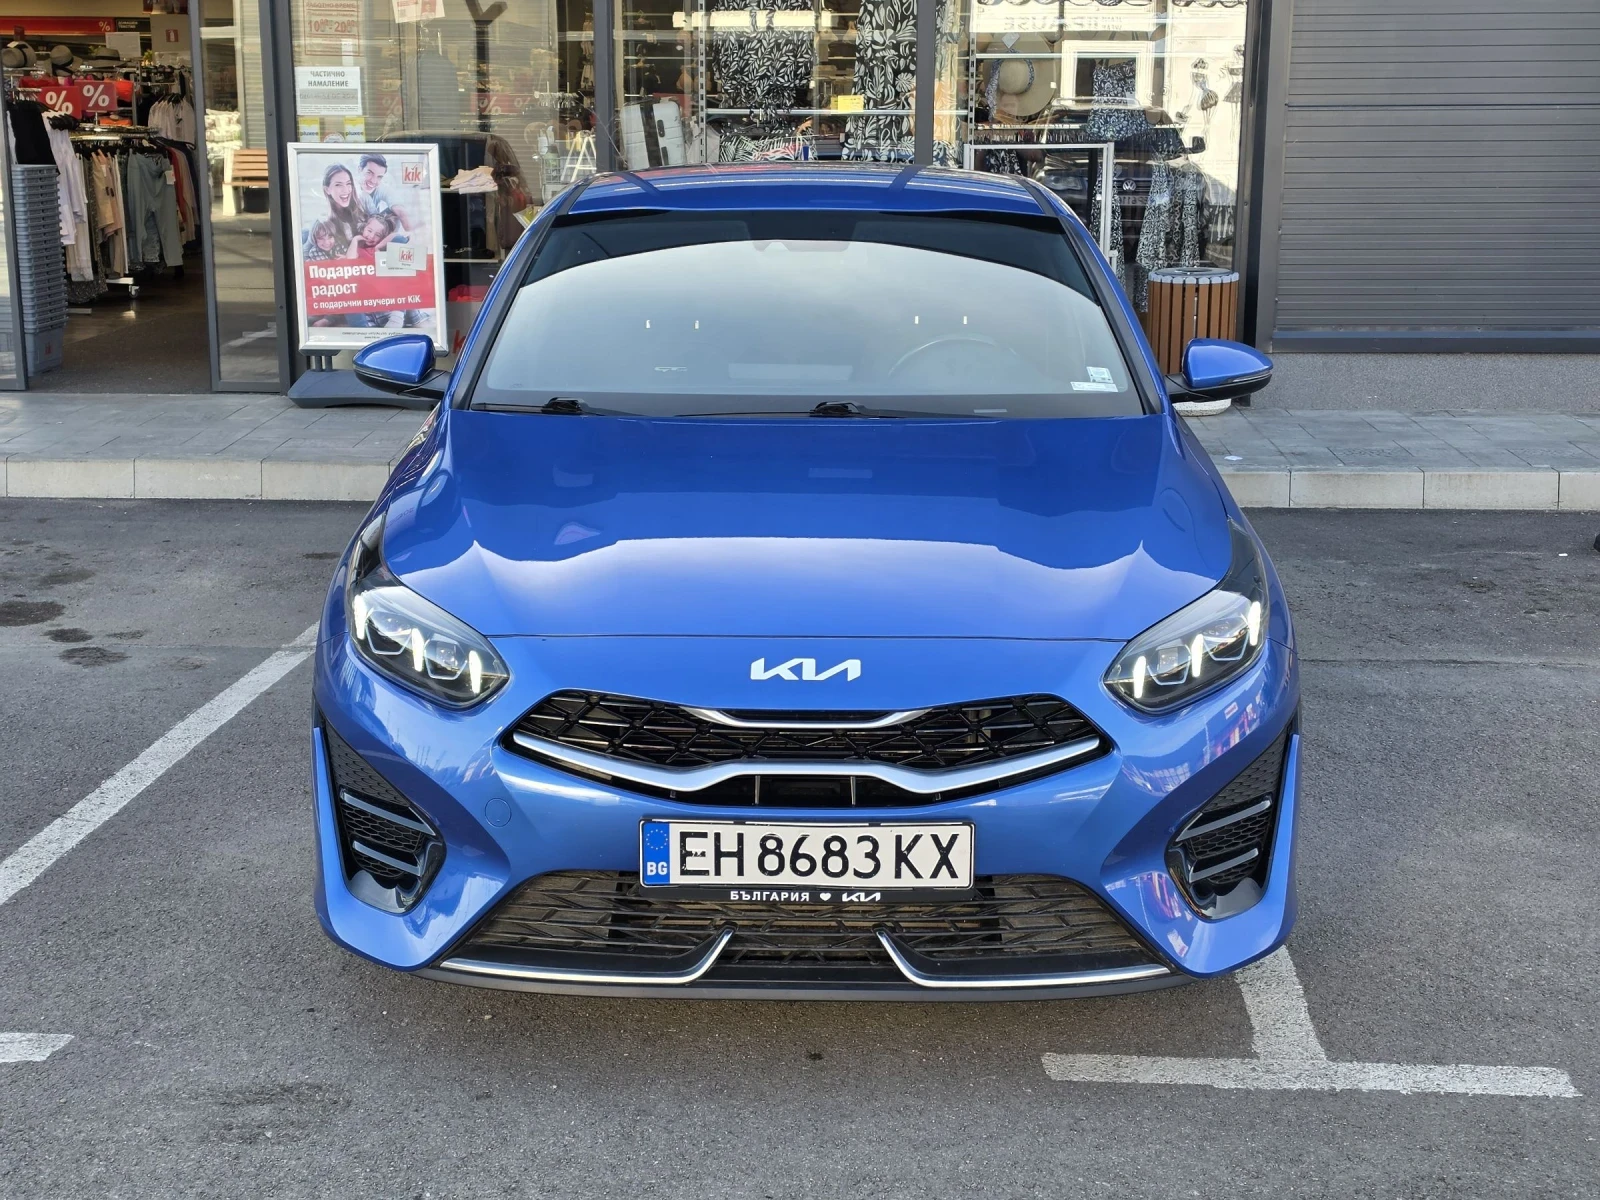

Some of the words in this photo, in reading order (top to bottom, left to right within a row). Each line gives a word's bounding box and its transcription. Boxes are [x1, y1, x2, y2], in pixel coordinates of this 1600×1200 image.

[310, 70, 345, 78] ЧАСТИЧНО
[309, 264, 375, 280] Подарете
[311, 283, 357, 299] радост
[319, 300, 362, 310] подаръчни
[363, 297, 395, 307] ваучери
[750, 657, 861, 682] KIA
[757, 833, 881, 879] 8683
[646, 862, 668, 876] BG
[730, 891, 810, 902] БЪЛГАРИЯ
[842, 892, 881, 902] KIA
